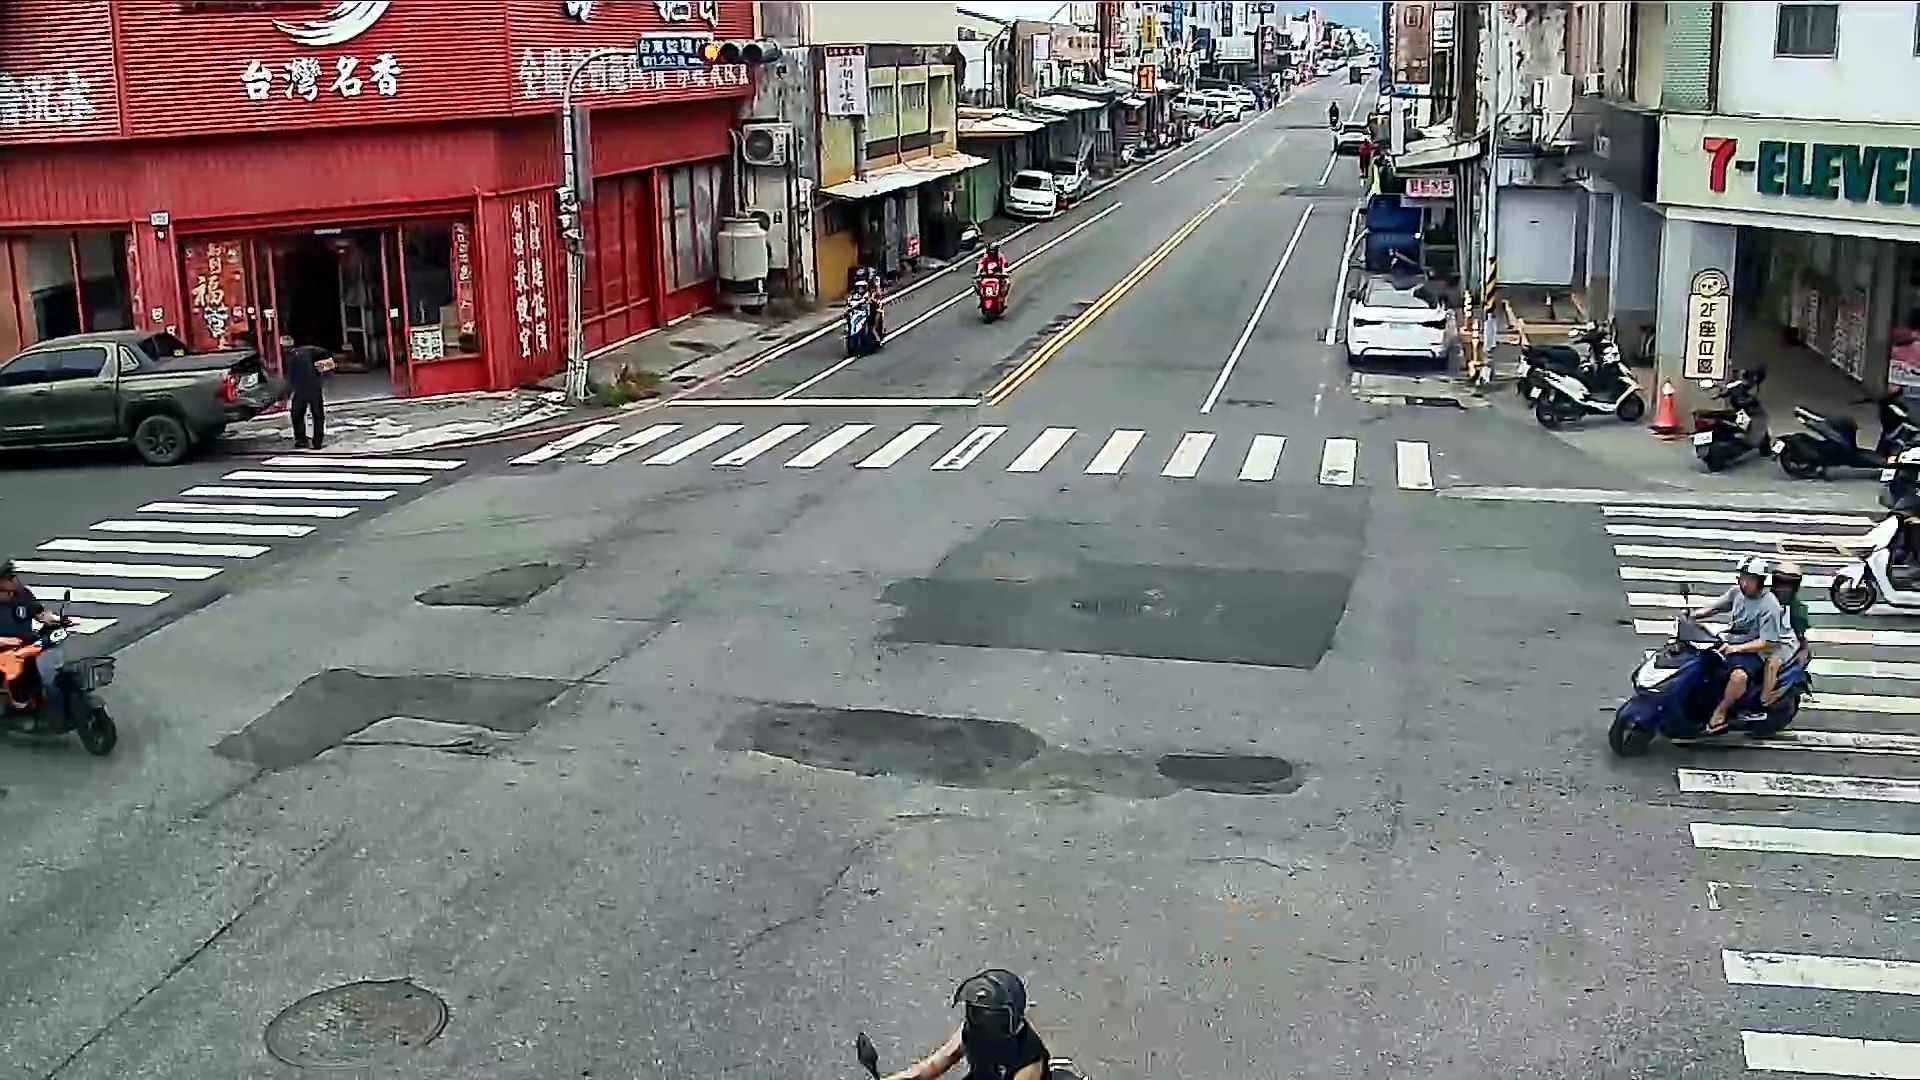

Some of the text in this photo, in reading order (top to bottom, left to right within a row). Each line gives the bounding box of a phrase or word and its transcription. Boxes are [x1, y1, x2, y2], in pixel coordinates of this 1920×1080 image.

[240, 52, 401, 101] 台灣名香
[1702, 136, 1920, 206] 7-ELEVE
[1700, 302, 1719, 318] 2F
[1697, 320, 1717, 374] 座位區
